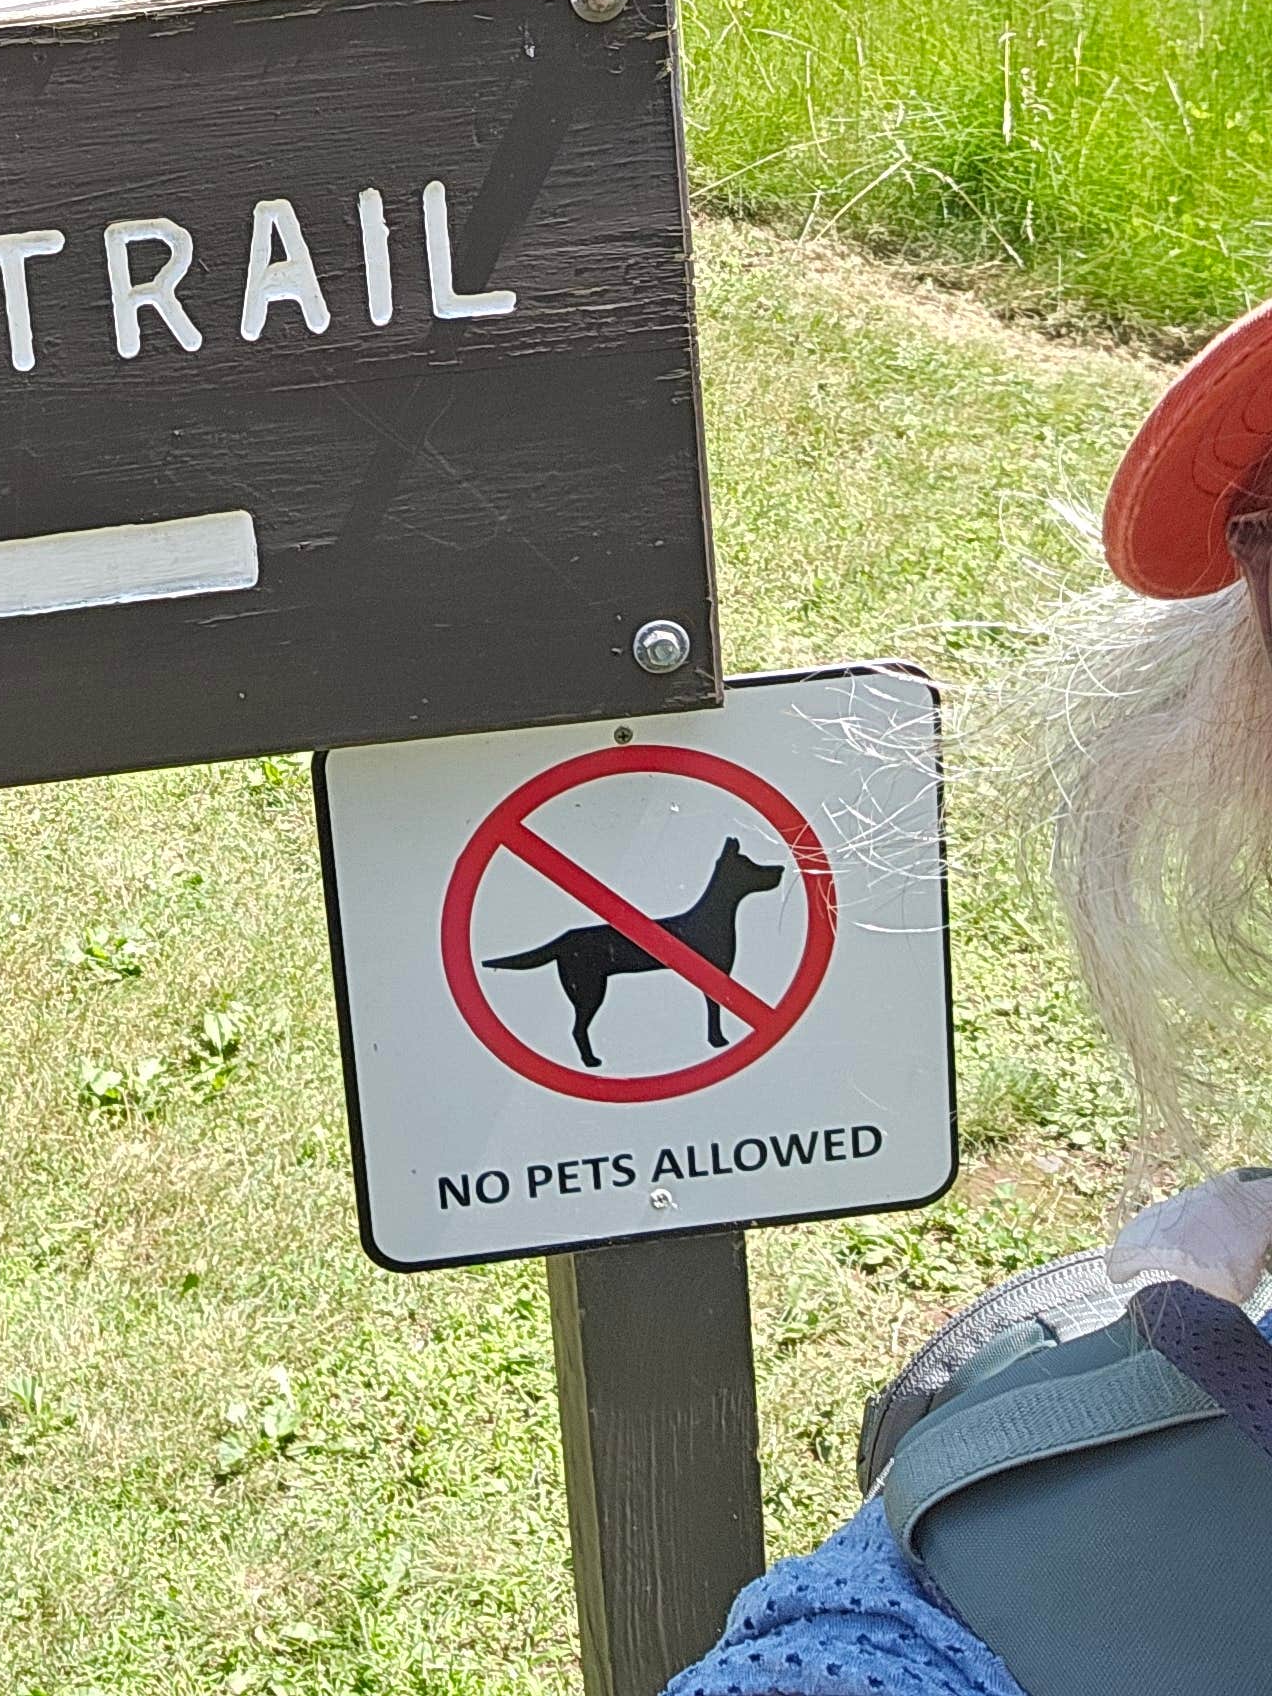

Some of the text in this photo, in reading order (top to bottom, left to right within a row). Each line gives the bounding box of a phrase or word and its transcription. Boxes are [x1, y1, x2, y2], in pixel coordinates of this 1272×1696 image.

[437, 1124, 884, 1210] NO PETS ALLOWED
